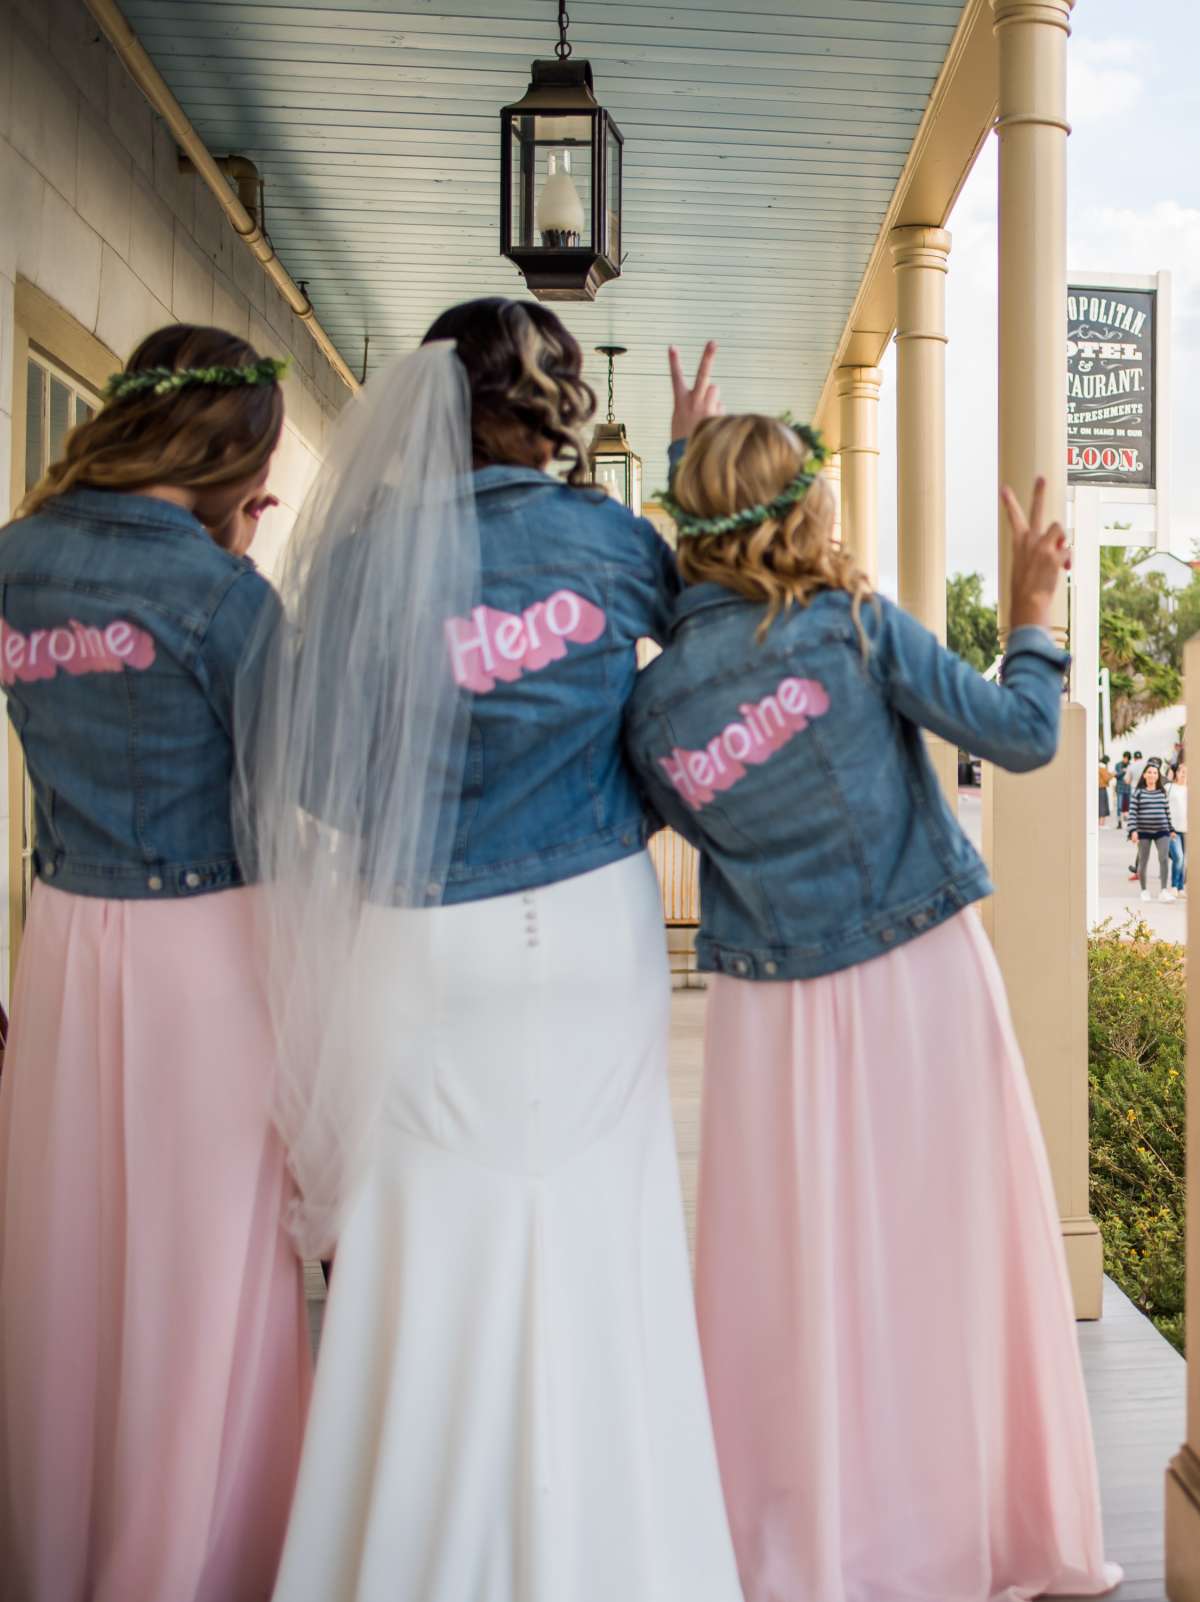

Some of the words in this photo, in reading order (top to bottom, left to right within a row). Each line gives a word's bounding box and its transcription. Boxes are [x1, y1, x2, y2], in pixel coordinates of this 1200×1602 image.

[1078, 360, 1094, 372] &
[446, 589, 585, 687] Hero
[659, 677, 812, 807] Heroine
